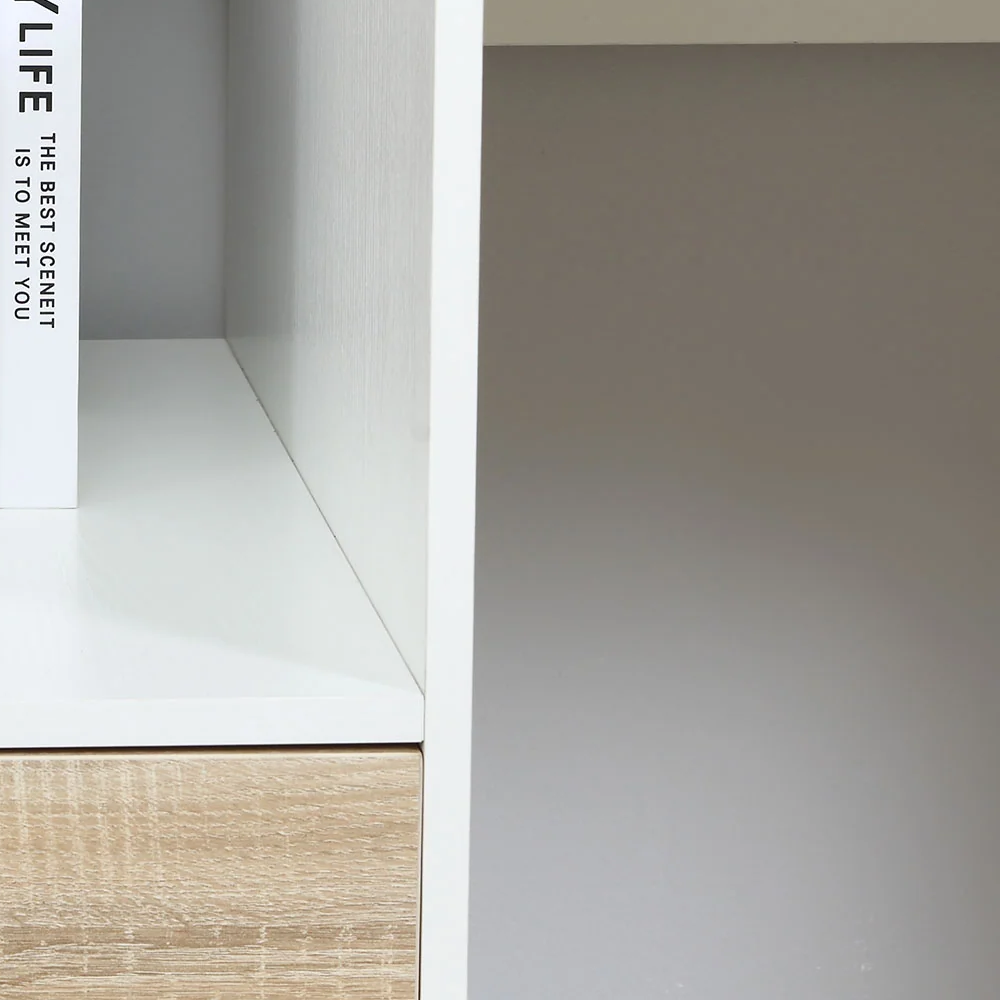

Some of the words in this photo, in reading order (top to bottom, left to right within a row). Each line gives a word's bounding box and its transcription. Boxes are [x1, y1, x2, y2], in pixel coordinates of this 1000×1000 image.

[19, 23, 53, 112] LIFE
[15, 149, 30, 167] IS
[41, 133, 55, 171] THE
[15, 177, 30, 203] TO
[40, 182, 55, 232] BEST
[15, 214, 30, 267] MEET
[15, 278, 30, 319] YOU
[40, 242, 55, 328] SCENEIT
